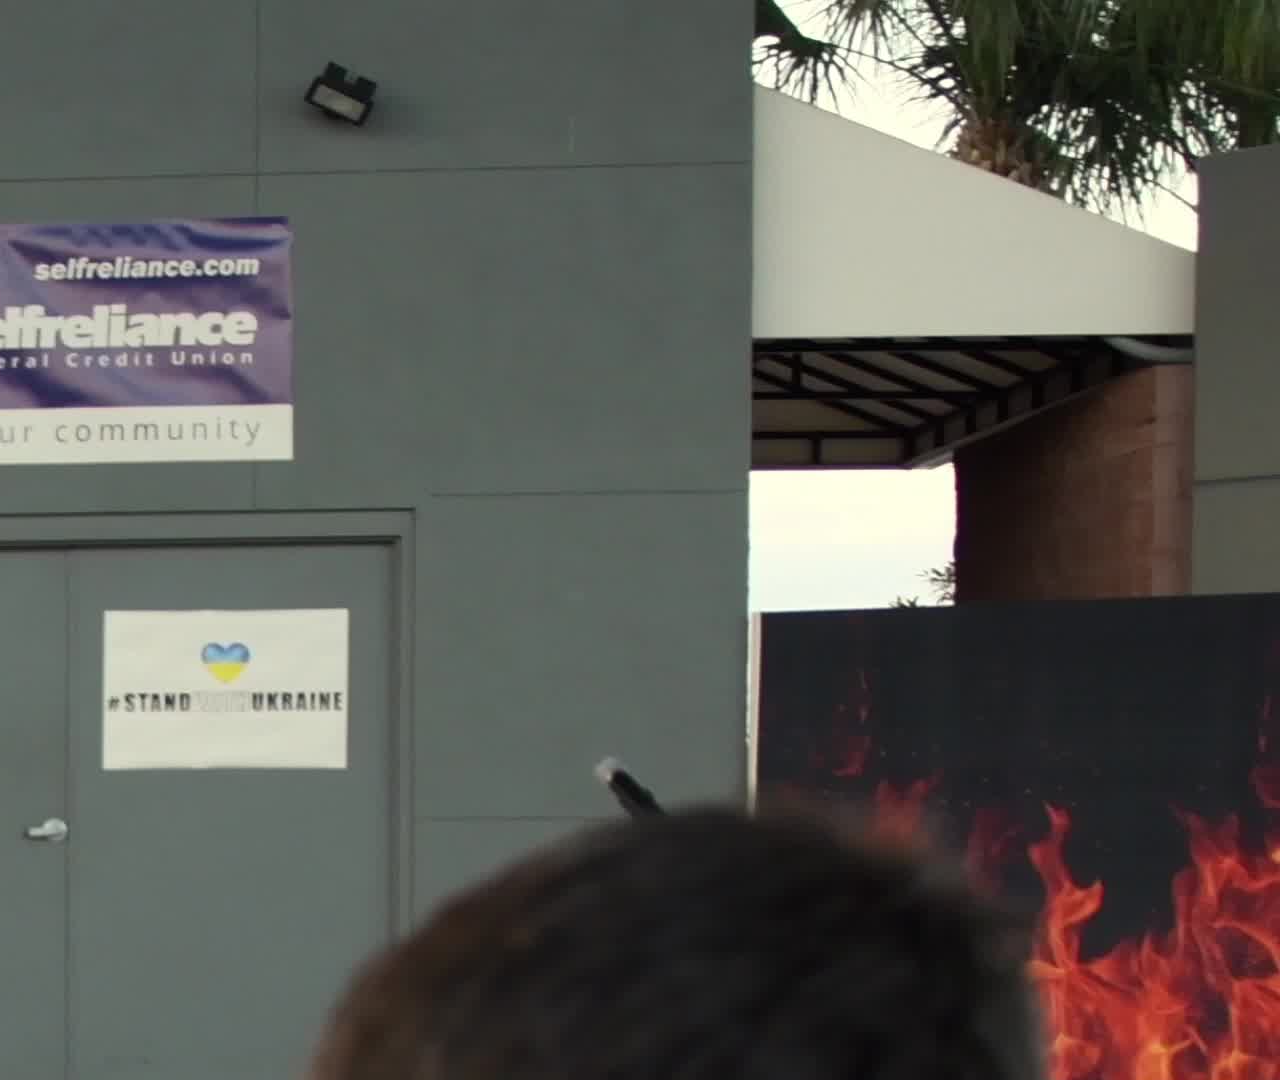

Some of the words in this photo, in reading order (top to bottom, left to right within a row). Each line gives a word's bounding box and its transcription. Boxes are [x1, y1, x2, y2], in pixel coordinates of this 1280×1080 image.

[34, 256, 260, 281] selfreliance.com
[65, 350, 156, 368] Credit
[171, 348, 255, 366] Union
[55, 415, 262, 449] community
[106, 692, 192, 713] #STAND
[251, 691, 344, 712] UKRAINE
